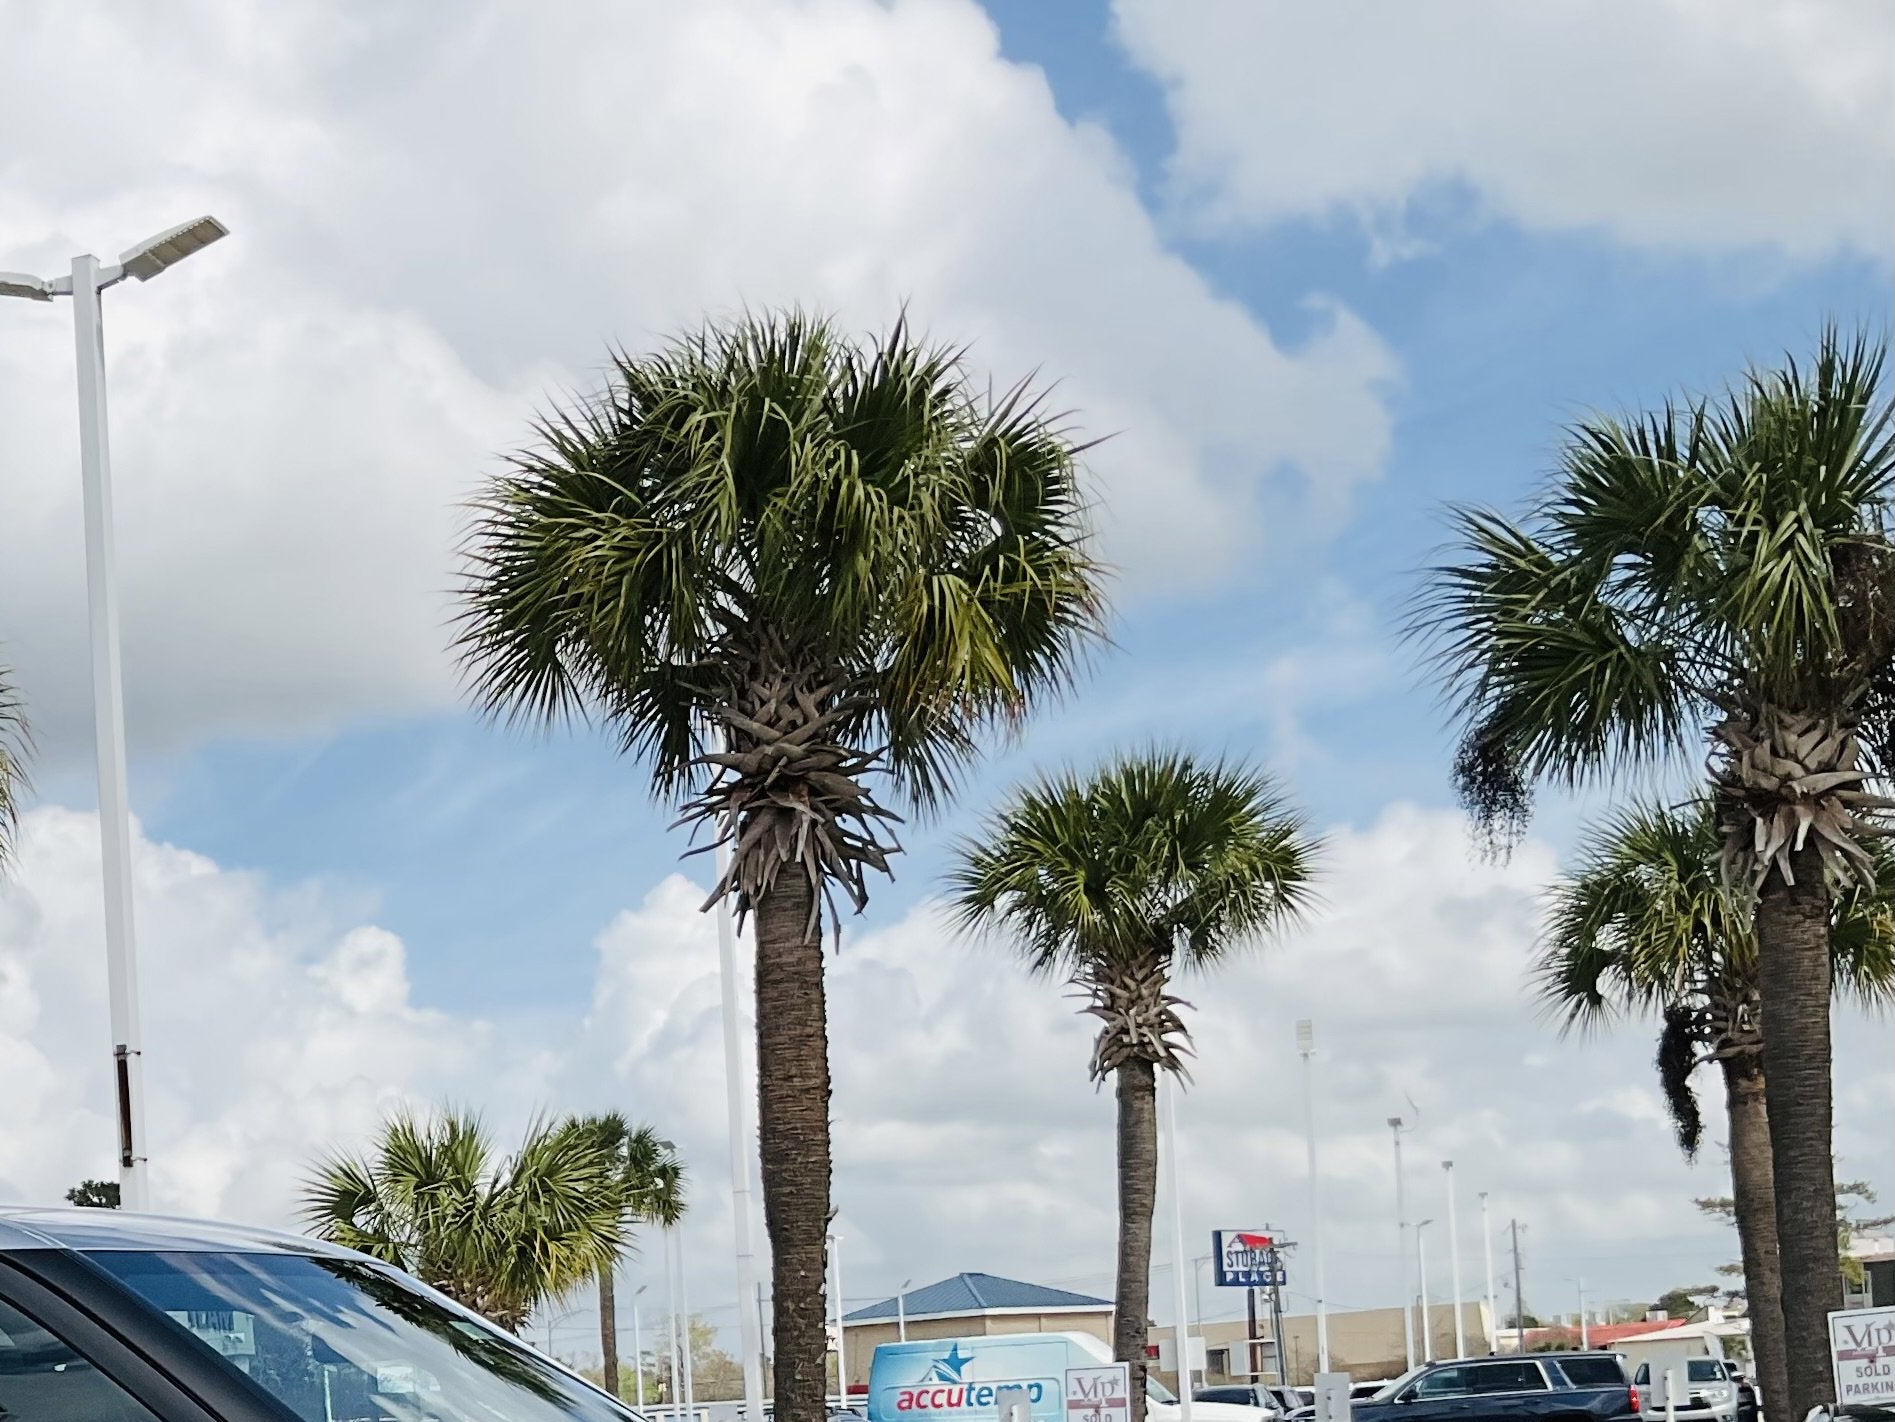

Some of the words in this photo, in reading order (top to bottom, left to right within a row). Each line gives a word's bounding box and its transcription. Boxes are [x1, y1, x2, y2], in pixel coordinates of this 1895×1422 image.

[1855, 1364, 1891, 1378] SOLD
[1845, 1381, 1895, 1396] PARKIN
[897, 1381, 1043, 1412] accutep
